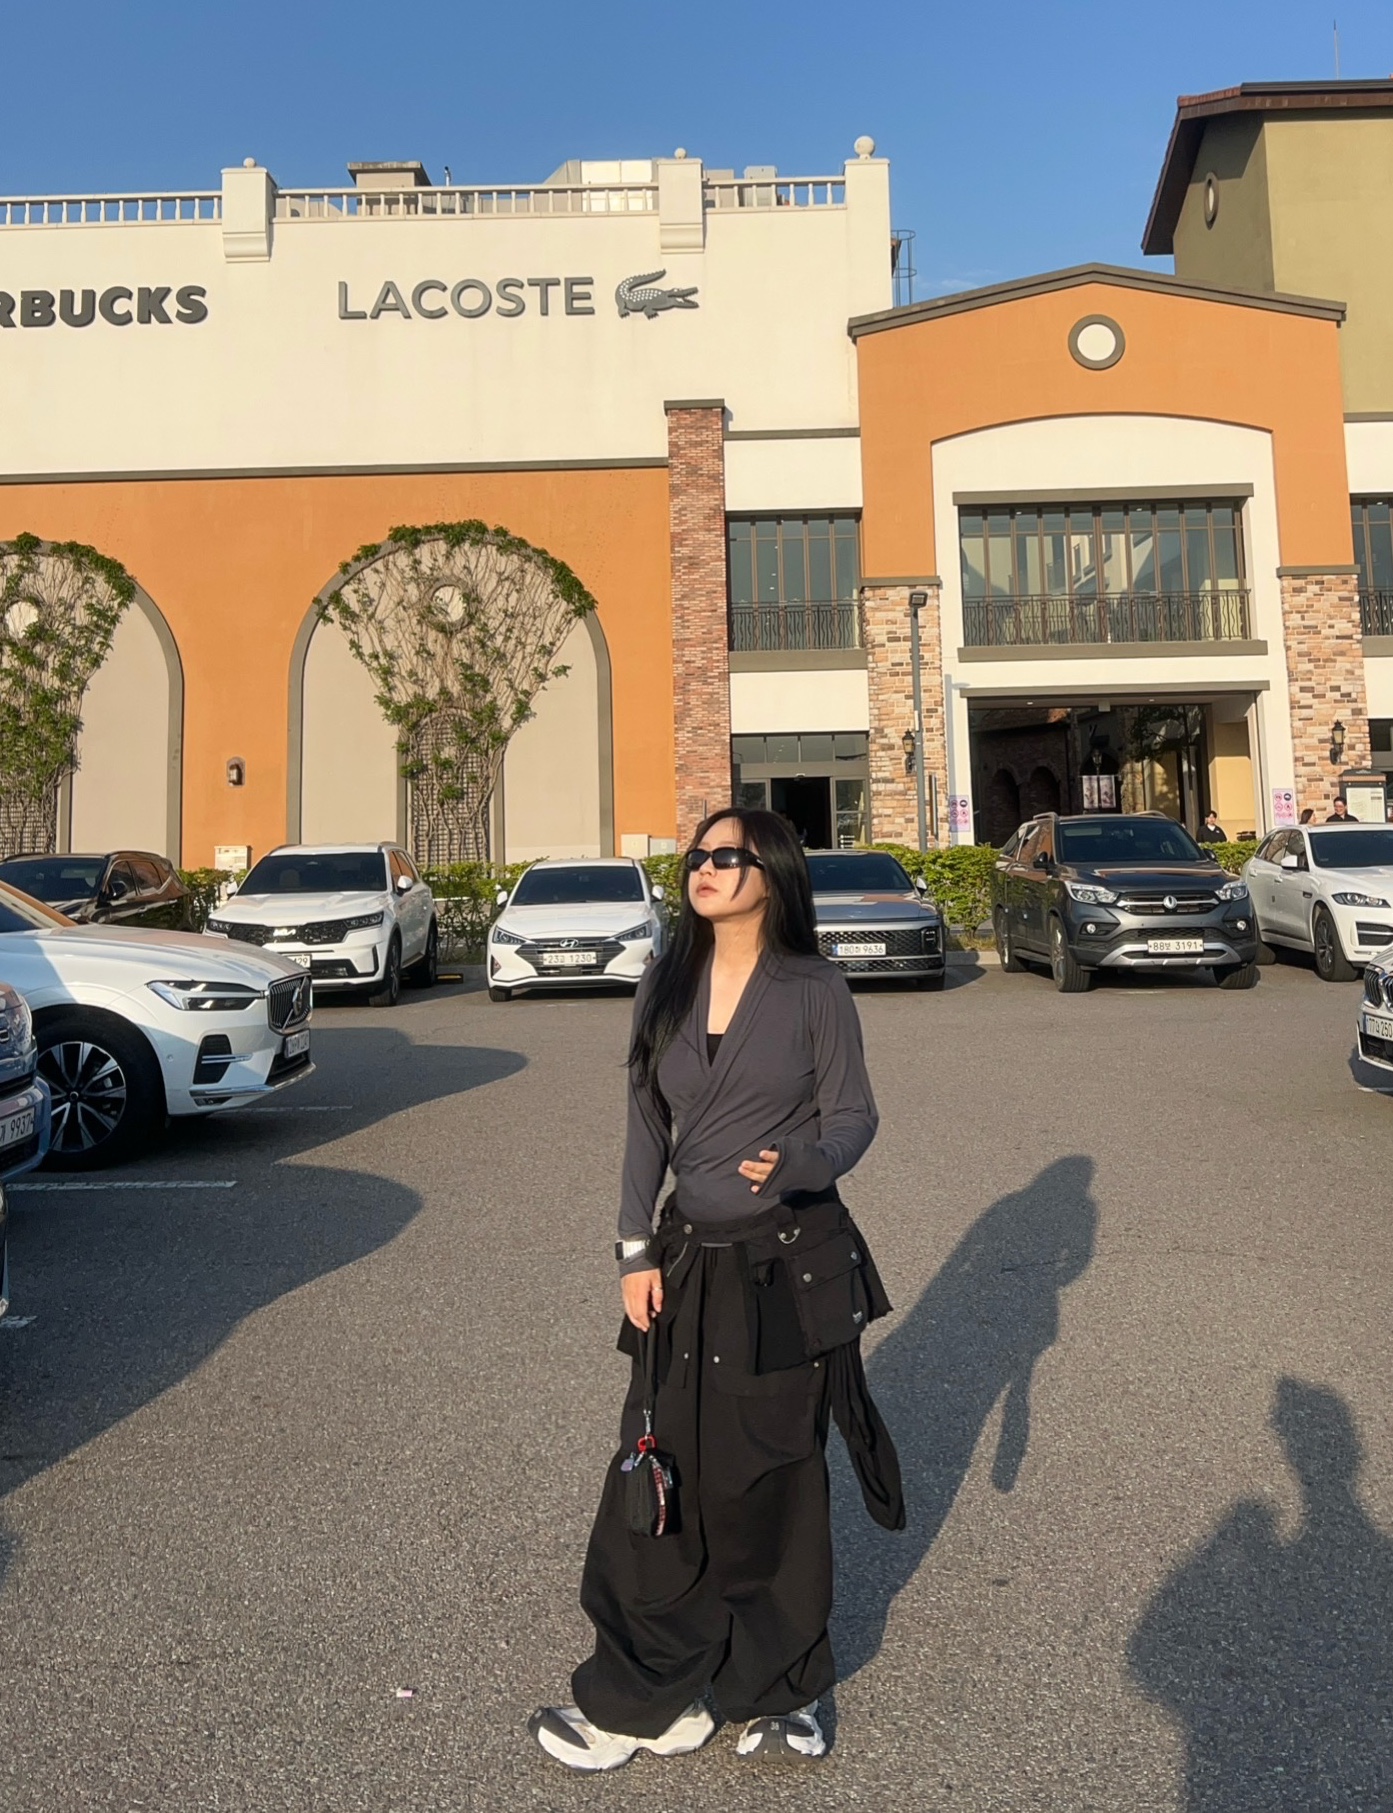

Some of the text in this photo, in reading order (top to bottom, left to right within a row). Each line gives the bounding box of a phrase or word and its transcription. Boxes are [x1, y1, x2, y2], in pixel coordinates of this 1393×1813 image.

[338, 276, 596, 320] LACOSTE
[863, 944, 884, 954] 9636
[1175, 941, 1198, 951] 3191
[11, 1113, 31, 1139] 9937
